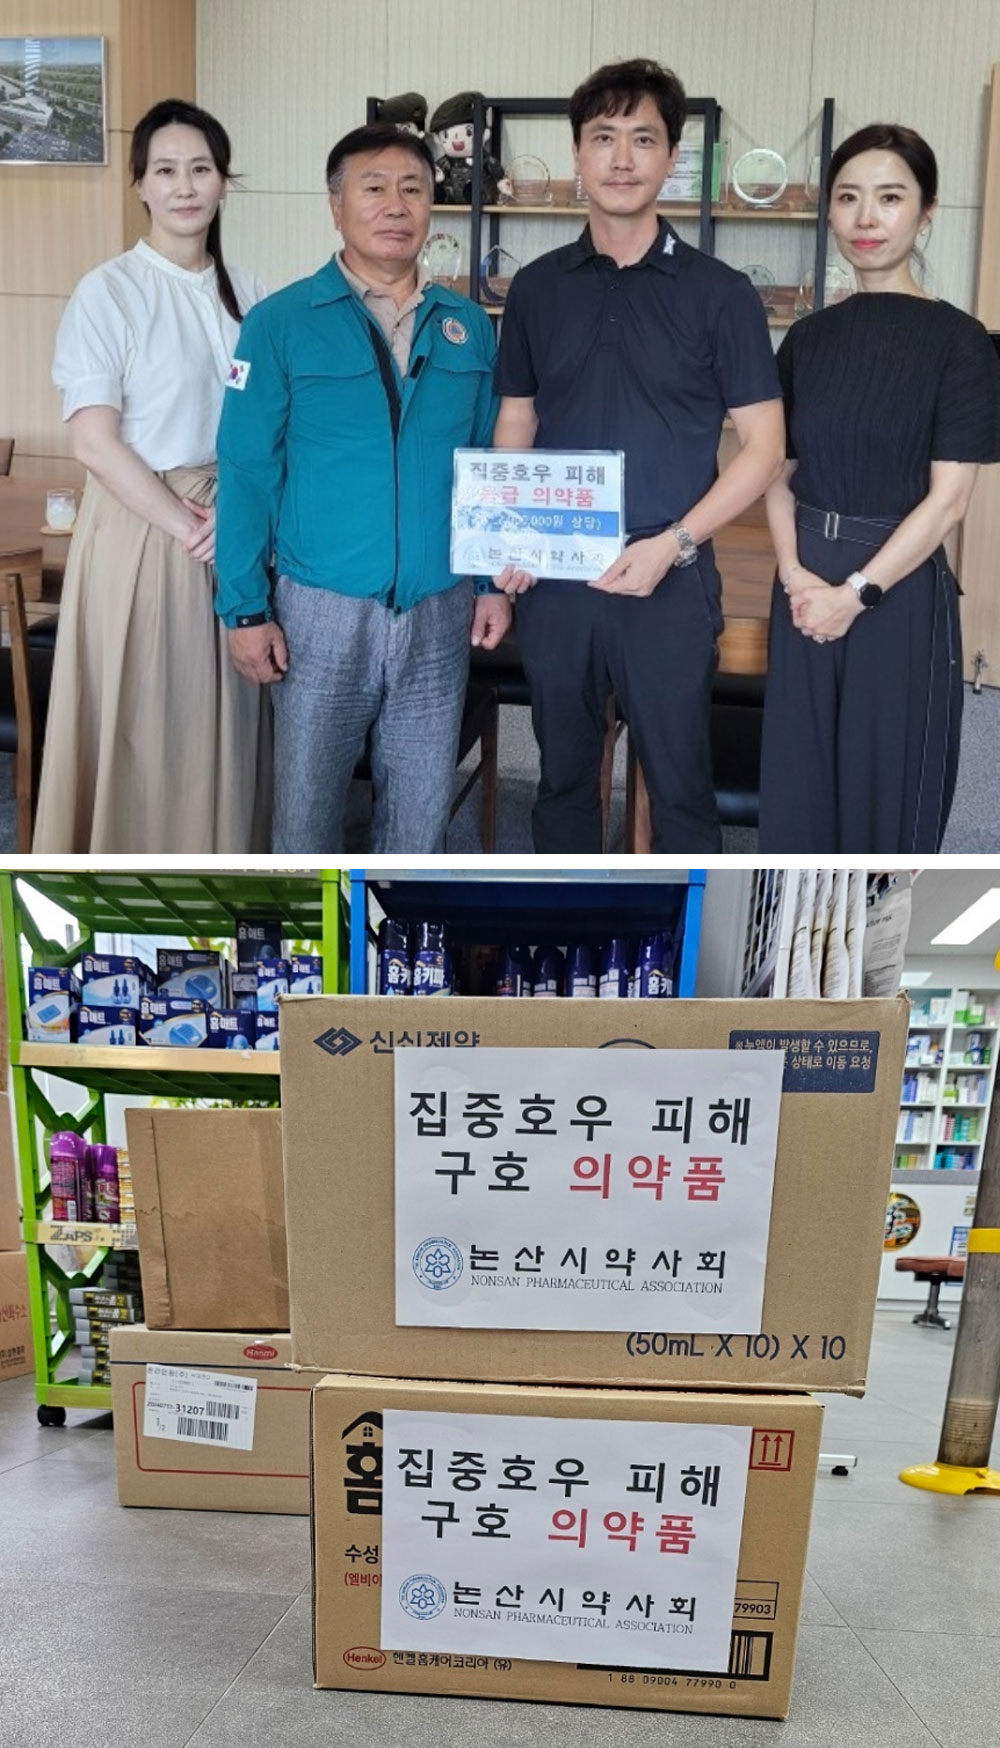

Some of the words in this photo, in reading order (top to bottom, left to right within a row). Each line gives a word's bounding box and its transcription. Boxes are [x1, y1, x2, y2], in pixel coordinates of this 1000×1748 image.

[565, 465, 606, 485] 피해
[532, 487, 594, 508] 의약품
[414, 966, 445, 989] 홈키파
[780, 1039, 811, 1053] 발생할
[813, 1039, 825, 1053] 수
[827, 1039, 873, 1054] 있으므로,
[791, 1055, 823, 1070] 상태로
[826, 1056, 847, 1070] 이동
[849, 1056, 872, 1070] 요청
[409, 1091, 612, 1142] 집중호우
[652, 1096, 751, 1145] 피해
[435, 1150, 530, 1195] 구호
[569, 1153, 726, 1201] 의약품
[469, 1244, 726, 1279] 논산시약사회
[470, 1275, 520, 1287] NONSAN
[526, 1277, 635, 1292] PHARMACEUTICAL
[640, 1281, 723, 1294] ASSOCIATION
[626, 1332, 704, 1357] (50mL
[745, 1334, 780, 1360] 10)
[790, 1335, 809, 1360] X
[821, 1335, 846, 1361] 10
[397, 1448, 589, 1498] 집중호우
[626, 1462, 721, 1507] 피해
[421, 1500, 511, 1539] 구호
[548, 1508, 696, 1554] 의약품
[344, 1544, 379, 1564] 수성
[453, 1582, 696, 1622] 논산시약사회
[454, 1608, 501, 1620] NONSAN
[506, 1611, 610, 1630] PHARMACEUTICAL
[615, 1620, 694, 1635] ASSOCIATION
[347, 1652, 383, 1664] Henkel
[493, 1656, 512, 1671] (유)
[607, 1673, 613, 1683] 1
[620, 1673, 635, 1684] 88
[642, 1675, 678, 1687] 09004
[686, 1678, 722, 1689] 77990
[729, 1680, 737, 1690] 0
